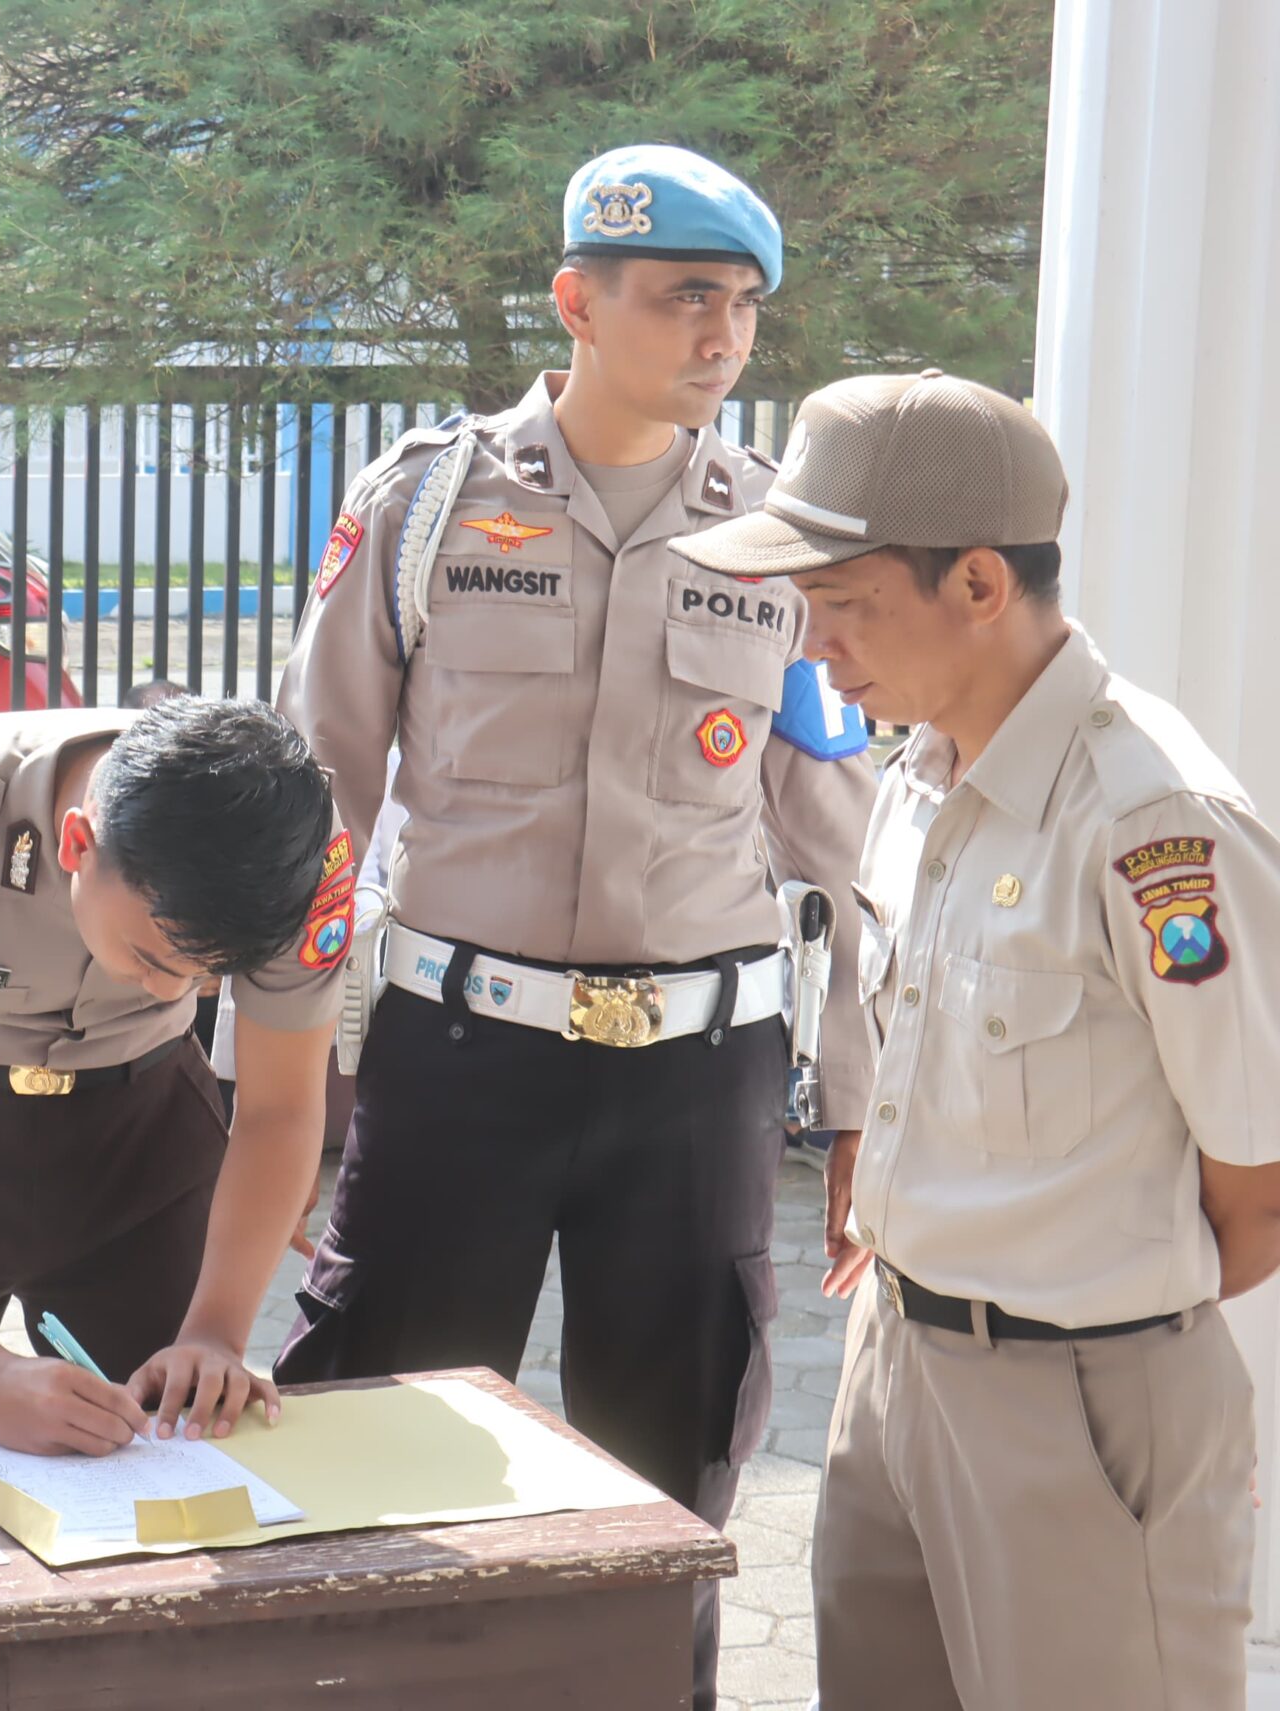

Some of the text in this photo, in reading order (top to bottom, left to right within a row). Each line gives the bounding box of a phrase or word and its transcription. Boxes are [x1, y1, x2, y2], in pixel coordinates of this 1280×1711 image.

[446, 565, 561, 596] WANGSIT
[682, 588, 785, 632] POLRI
[1124, 840, 1202, 870] POLRES
[1183, 851, 1205, 863] KOTA
[1141, 878, 1210, 902] JAWA TIMUR
[415, 955, 484, 995] PROS
